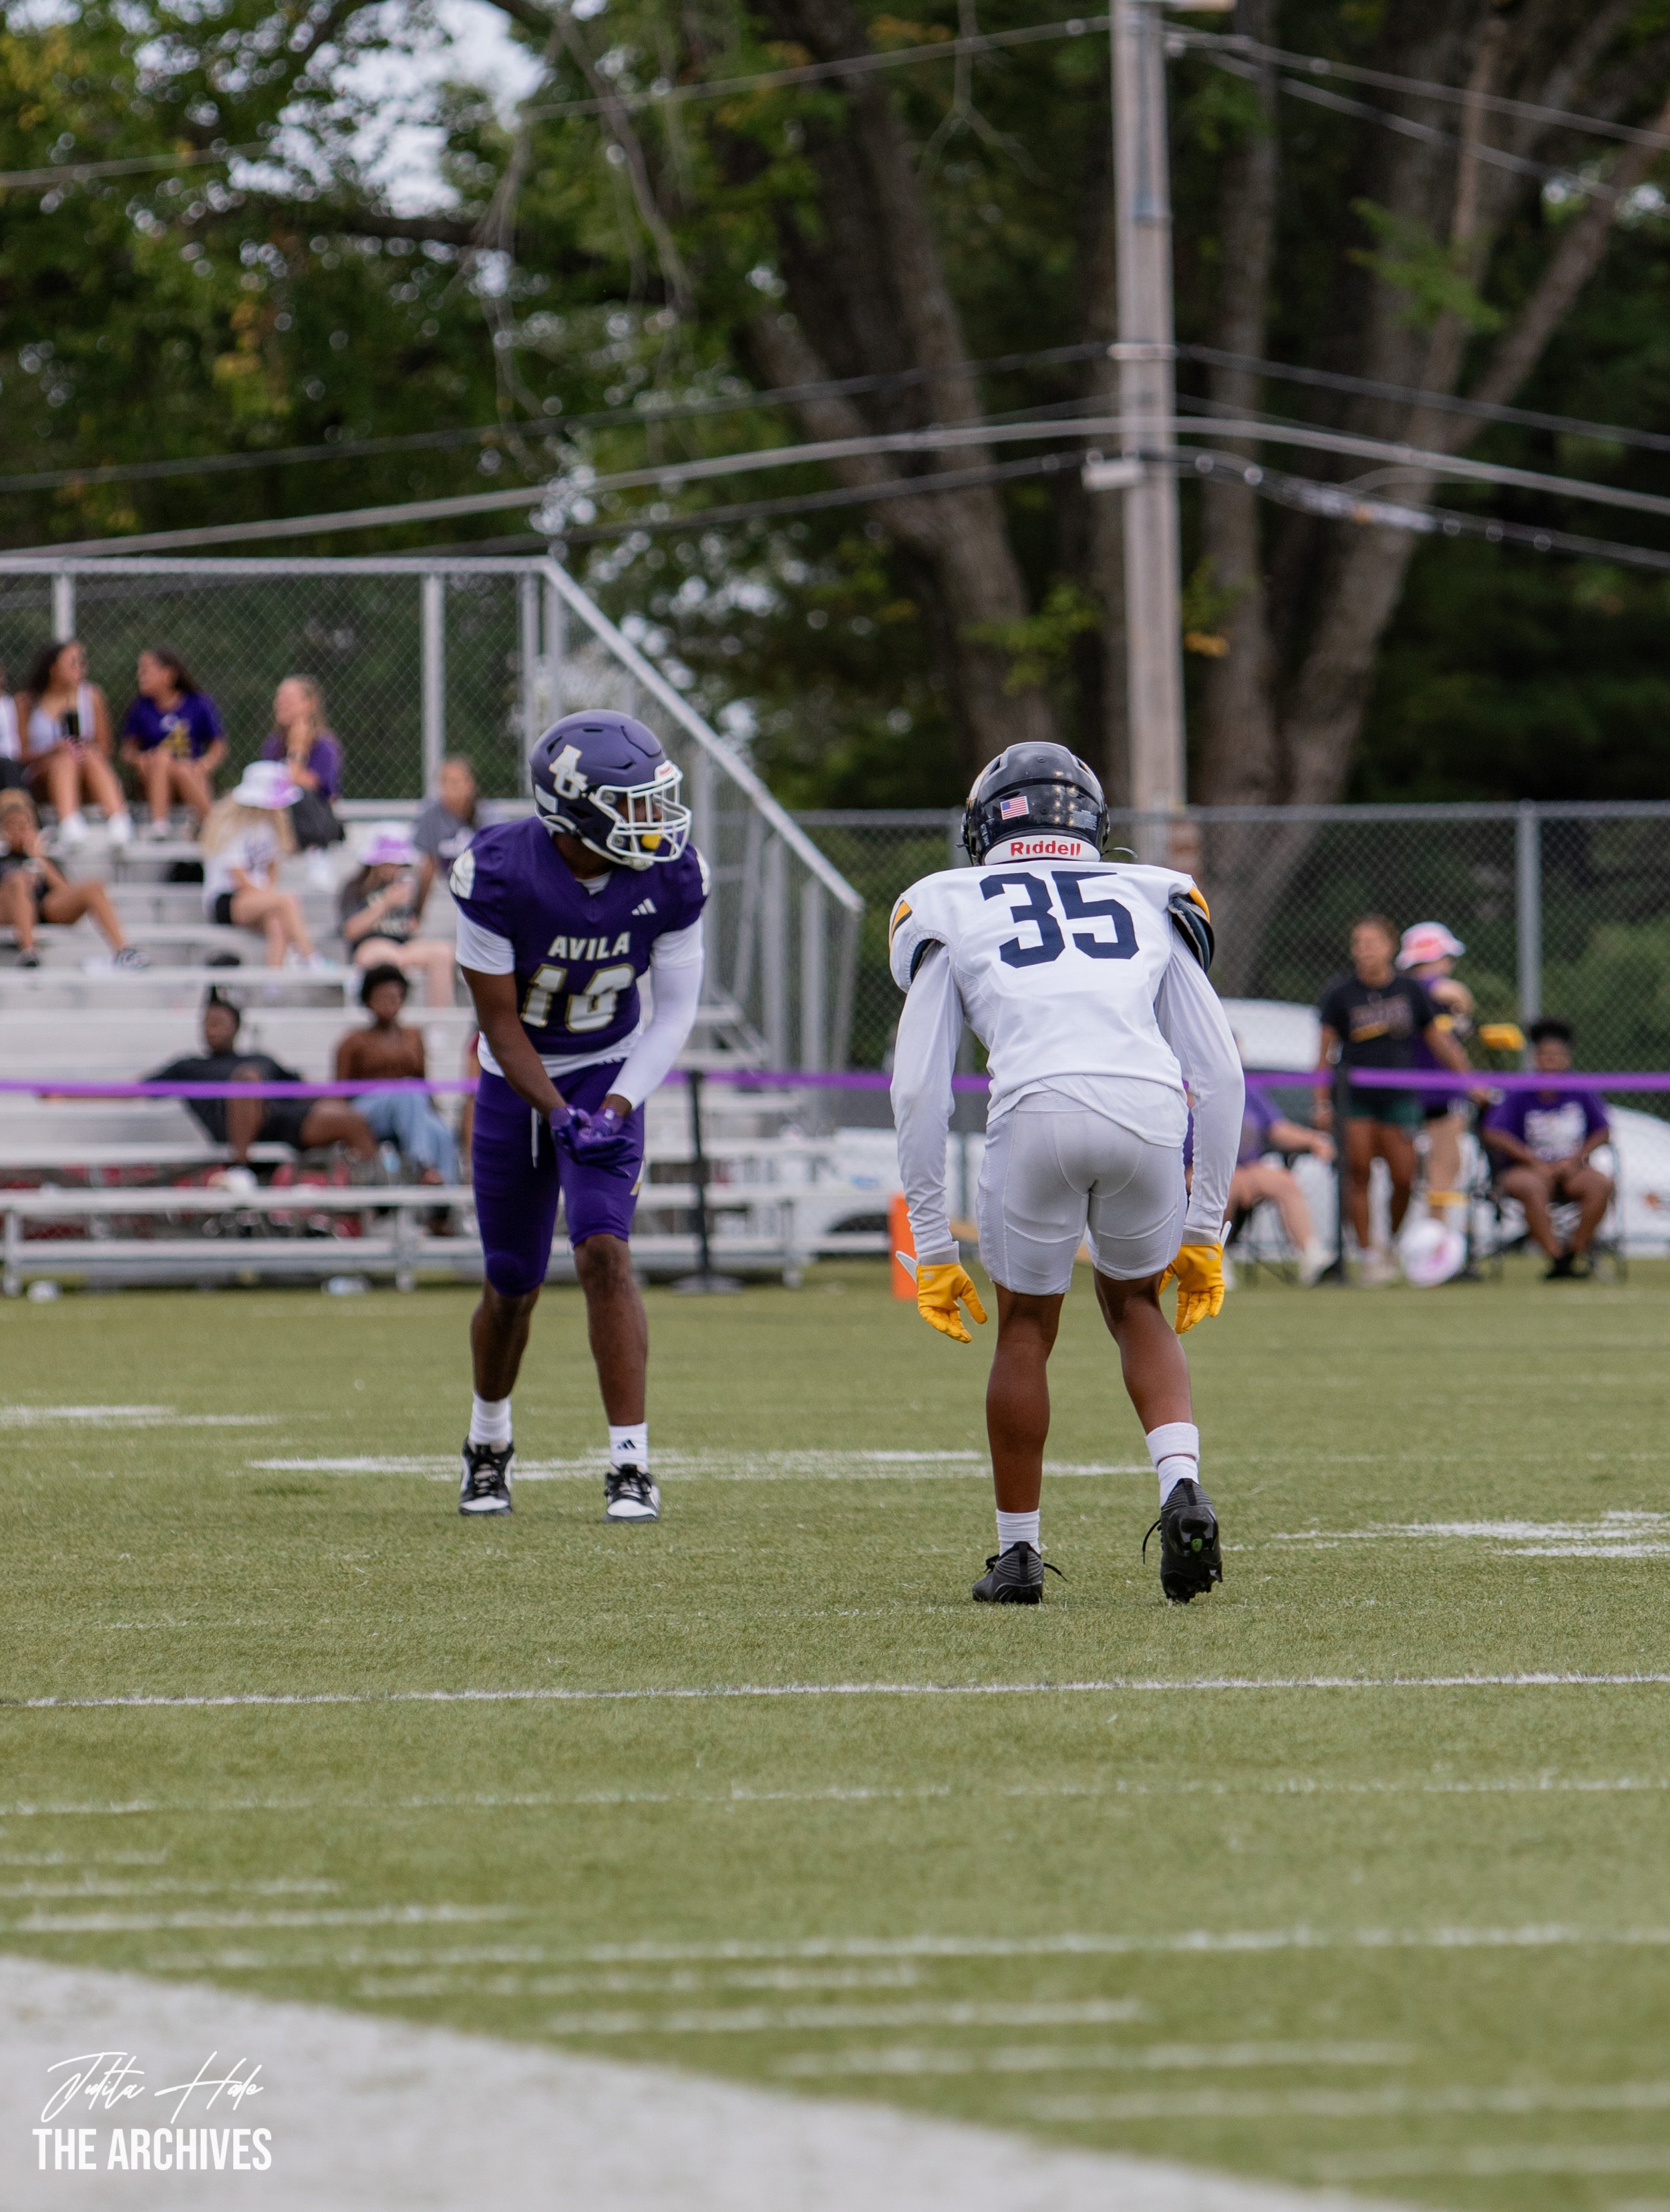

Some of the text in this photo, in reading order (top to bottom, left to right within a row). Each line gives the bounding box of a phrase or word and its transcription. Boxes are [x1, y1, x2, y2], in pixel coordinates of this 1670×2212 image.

[1010, 840, 1081, 856] Riddell
[979, 870, 1140, 969] 35
[548, 931, 631, 961] AVILA
